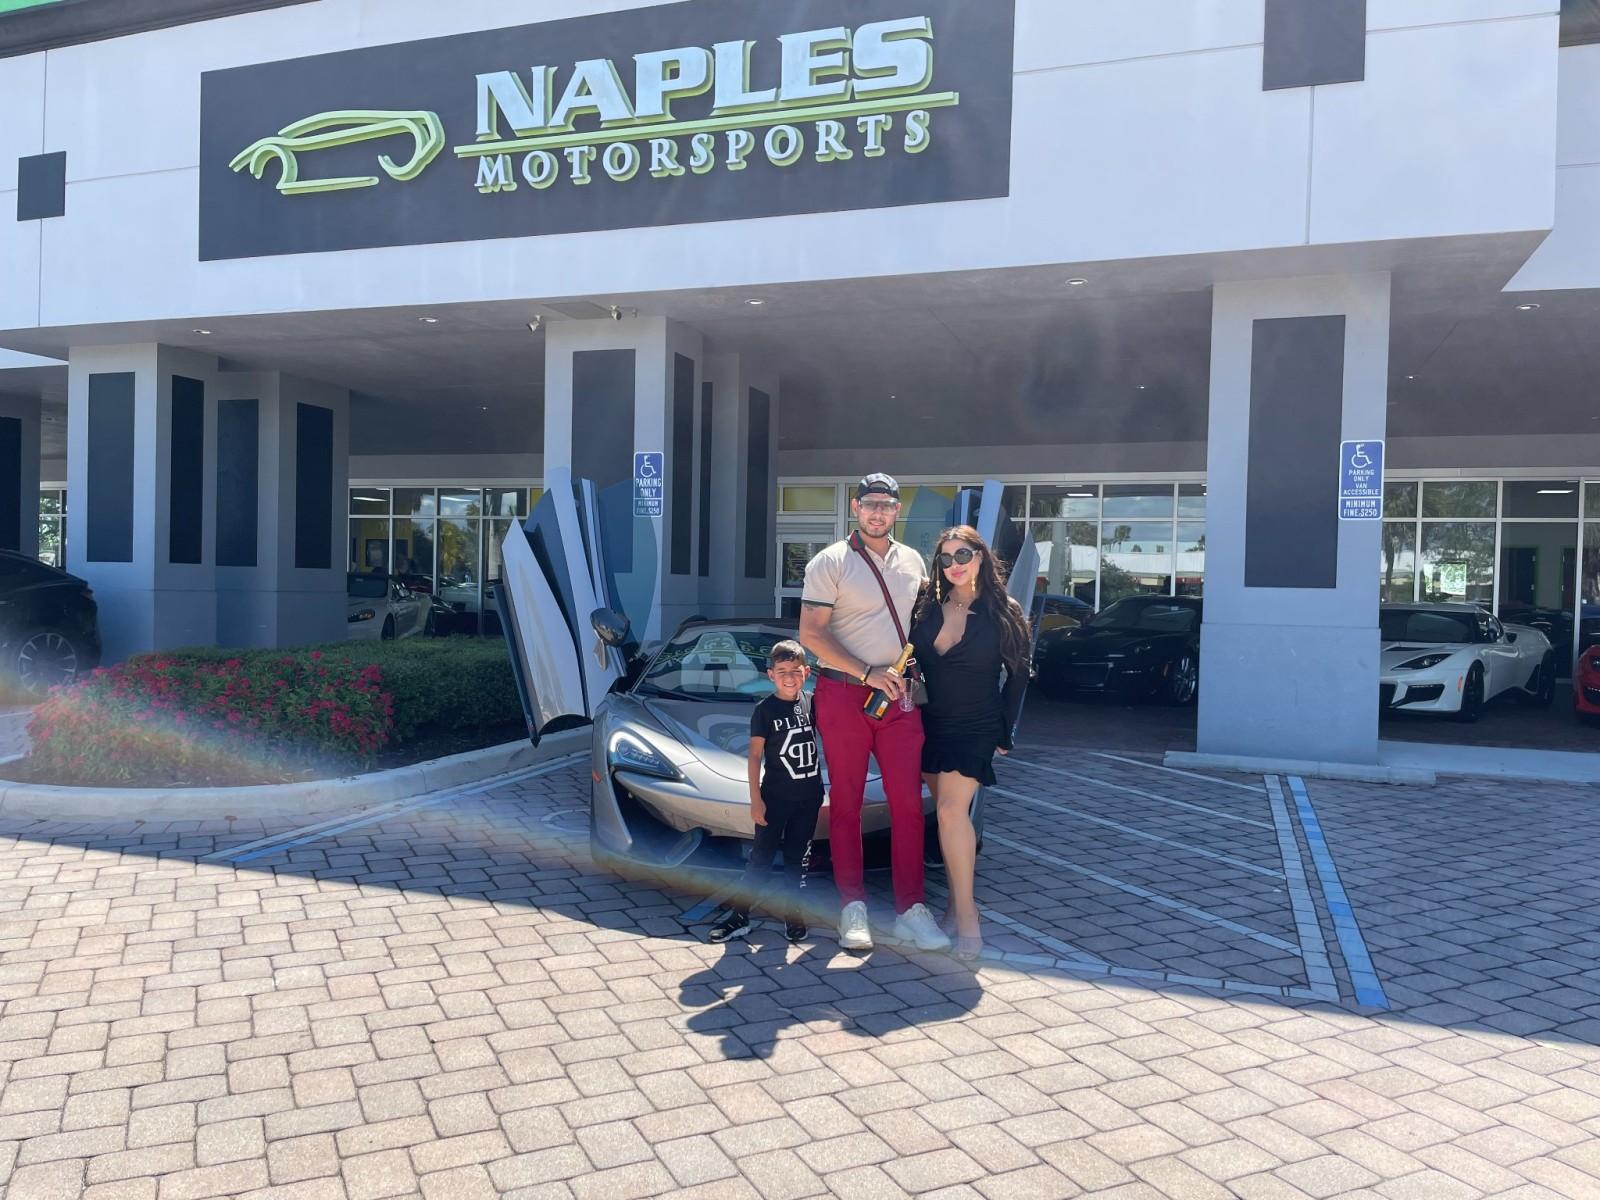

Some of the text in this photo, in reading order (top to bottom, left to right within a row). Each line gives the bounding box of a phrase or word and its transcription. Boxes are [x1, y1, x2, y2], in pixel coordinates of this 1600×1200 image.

[475, 16, 933, 141] NAPLES
[474, 110, 930, 193] MOTORSPORTS
[635, 478, 662, 488] PARKING
[640, 487, 657, 498] ONLY
[1343, 488, 1380, 496] ACCESSIBLE
[1345, 499, 1376, 508] MINIMUM
